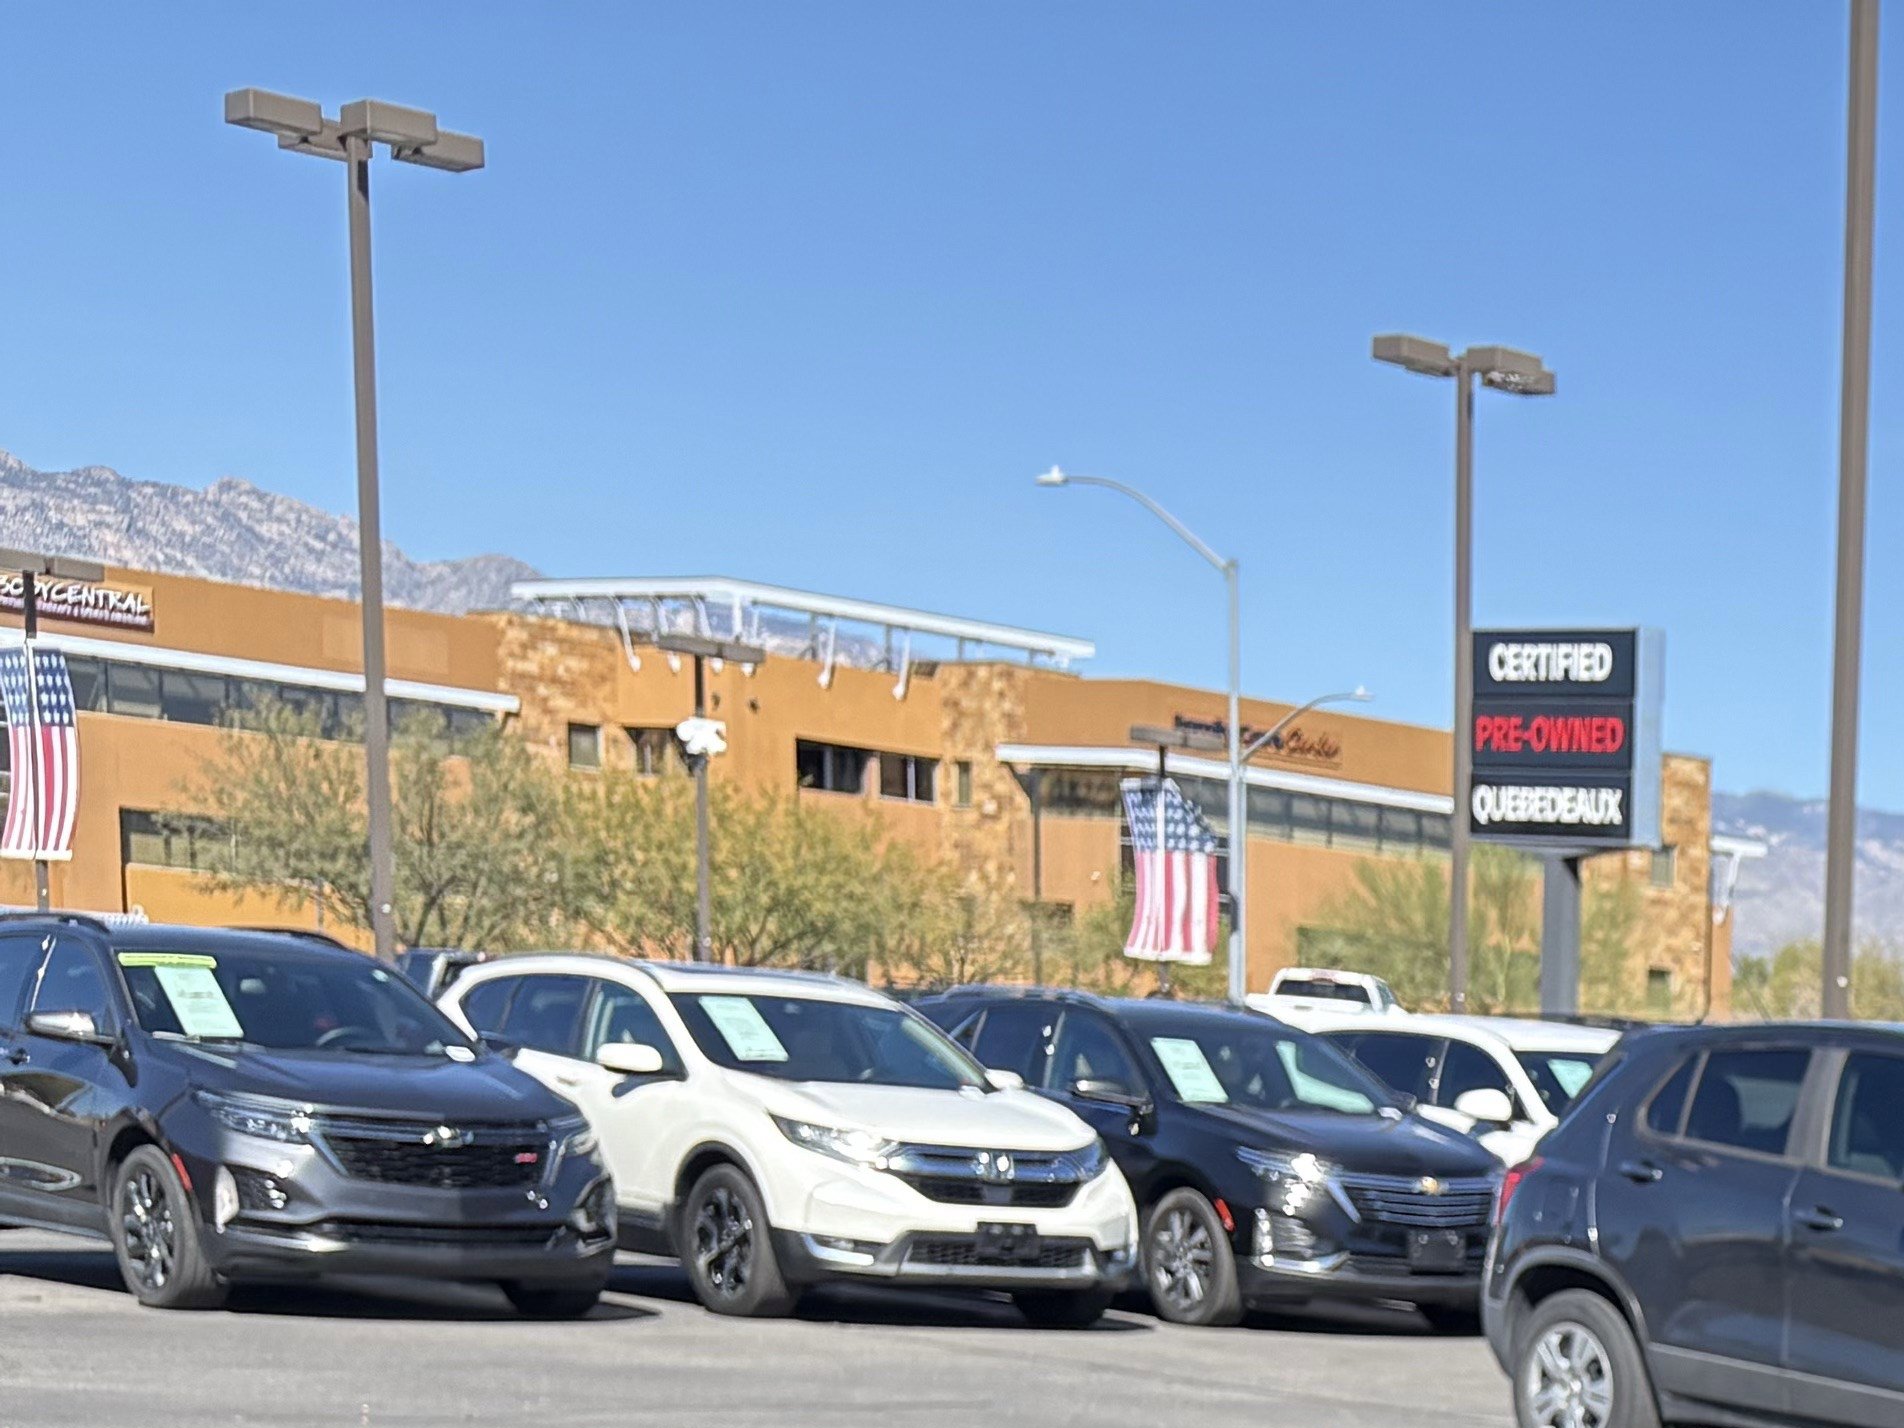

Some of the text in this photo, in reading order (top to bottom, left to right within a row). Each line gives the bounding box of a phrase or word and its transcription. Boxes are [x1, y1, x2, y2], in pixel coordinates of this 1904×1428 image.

[1489, 643, 1613, 682] CERTIFIED
[1475, 715, 1625, 753] PRE-OWNED
[1472, 784, 1623, 825] QUEBEDEAUX
